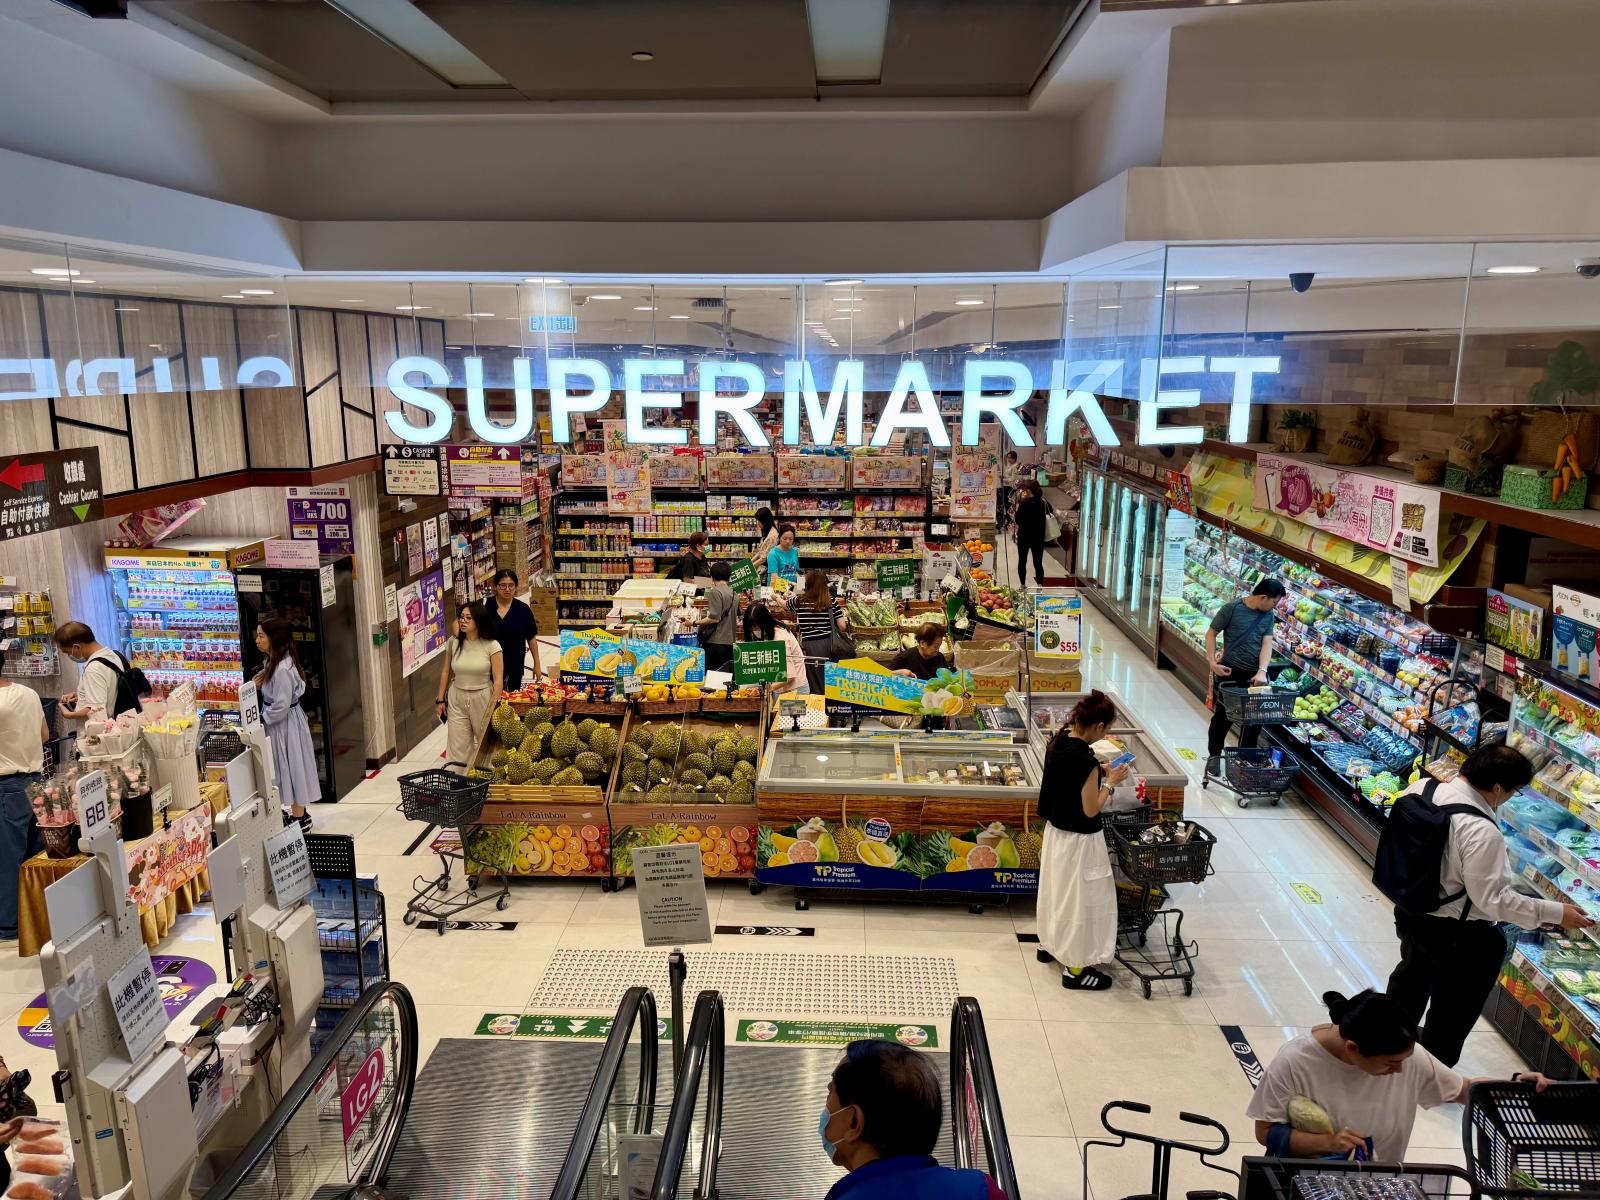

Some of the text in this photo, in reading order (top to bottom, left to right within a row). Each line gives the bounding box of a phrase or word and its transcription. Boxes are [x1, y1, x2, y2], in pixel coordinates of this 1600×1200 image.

[384, 356, 1281, 448] SUPERMARKET
[4, 498, 12, 507] Self
[13, 497, 27, 506] Service
[59, 488, 98, 506] Cashier Counter
[1, 502, 50, 526] 自助付款快線
[317, 503, 347, 519] 700
[235, 550, 258, 564] KAGOME
[1060, 641, 1078, 652] $55
[742, 650, 779, 666] 周三新鮮日
[834, 677, 894, 696] TROPICAL
[840, 689, 885, 706] FESTIVAL
[529, 811, 567, 819] Rainbow
[680, 812, 716, 820] Rainbow
[270, 838, 304, 865] 此機暫停
[815, 866, 832, 876] TP
[994, 872, 1012, 883] TP
[115, 966, 152, 1013] 此機暫停
[350, 1056, 380, 1126] LG2
